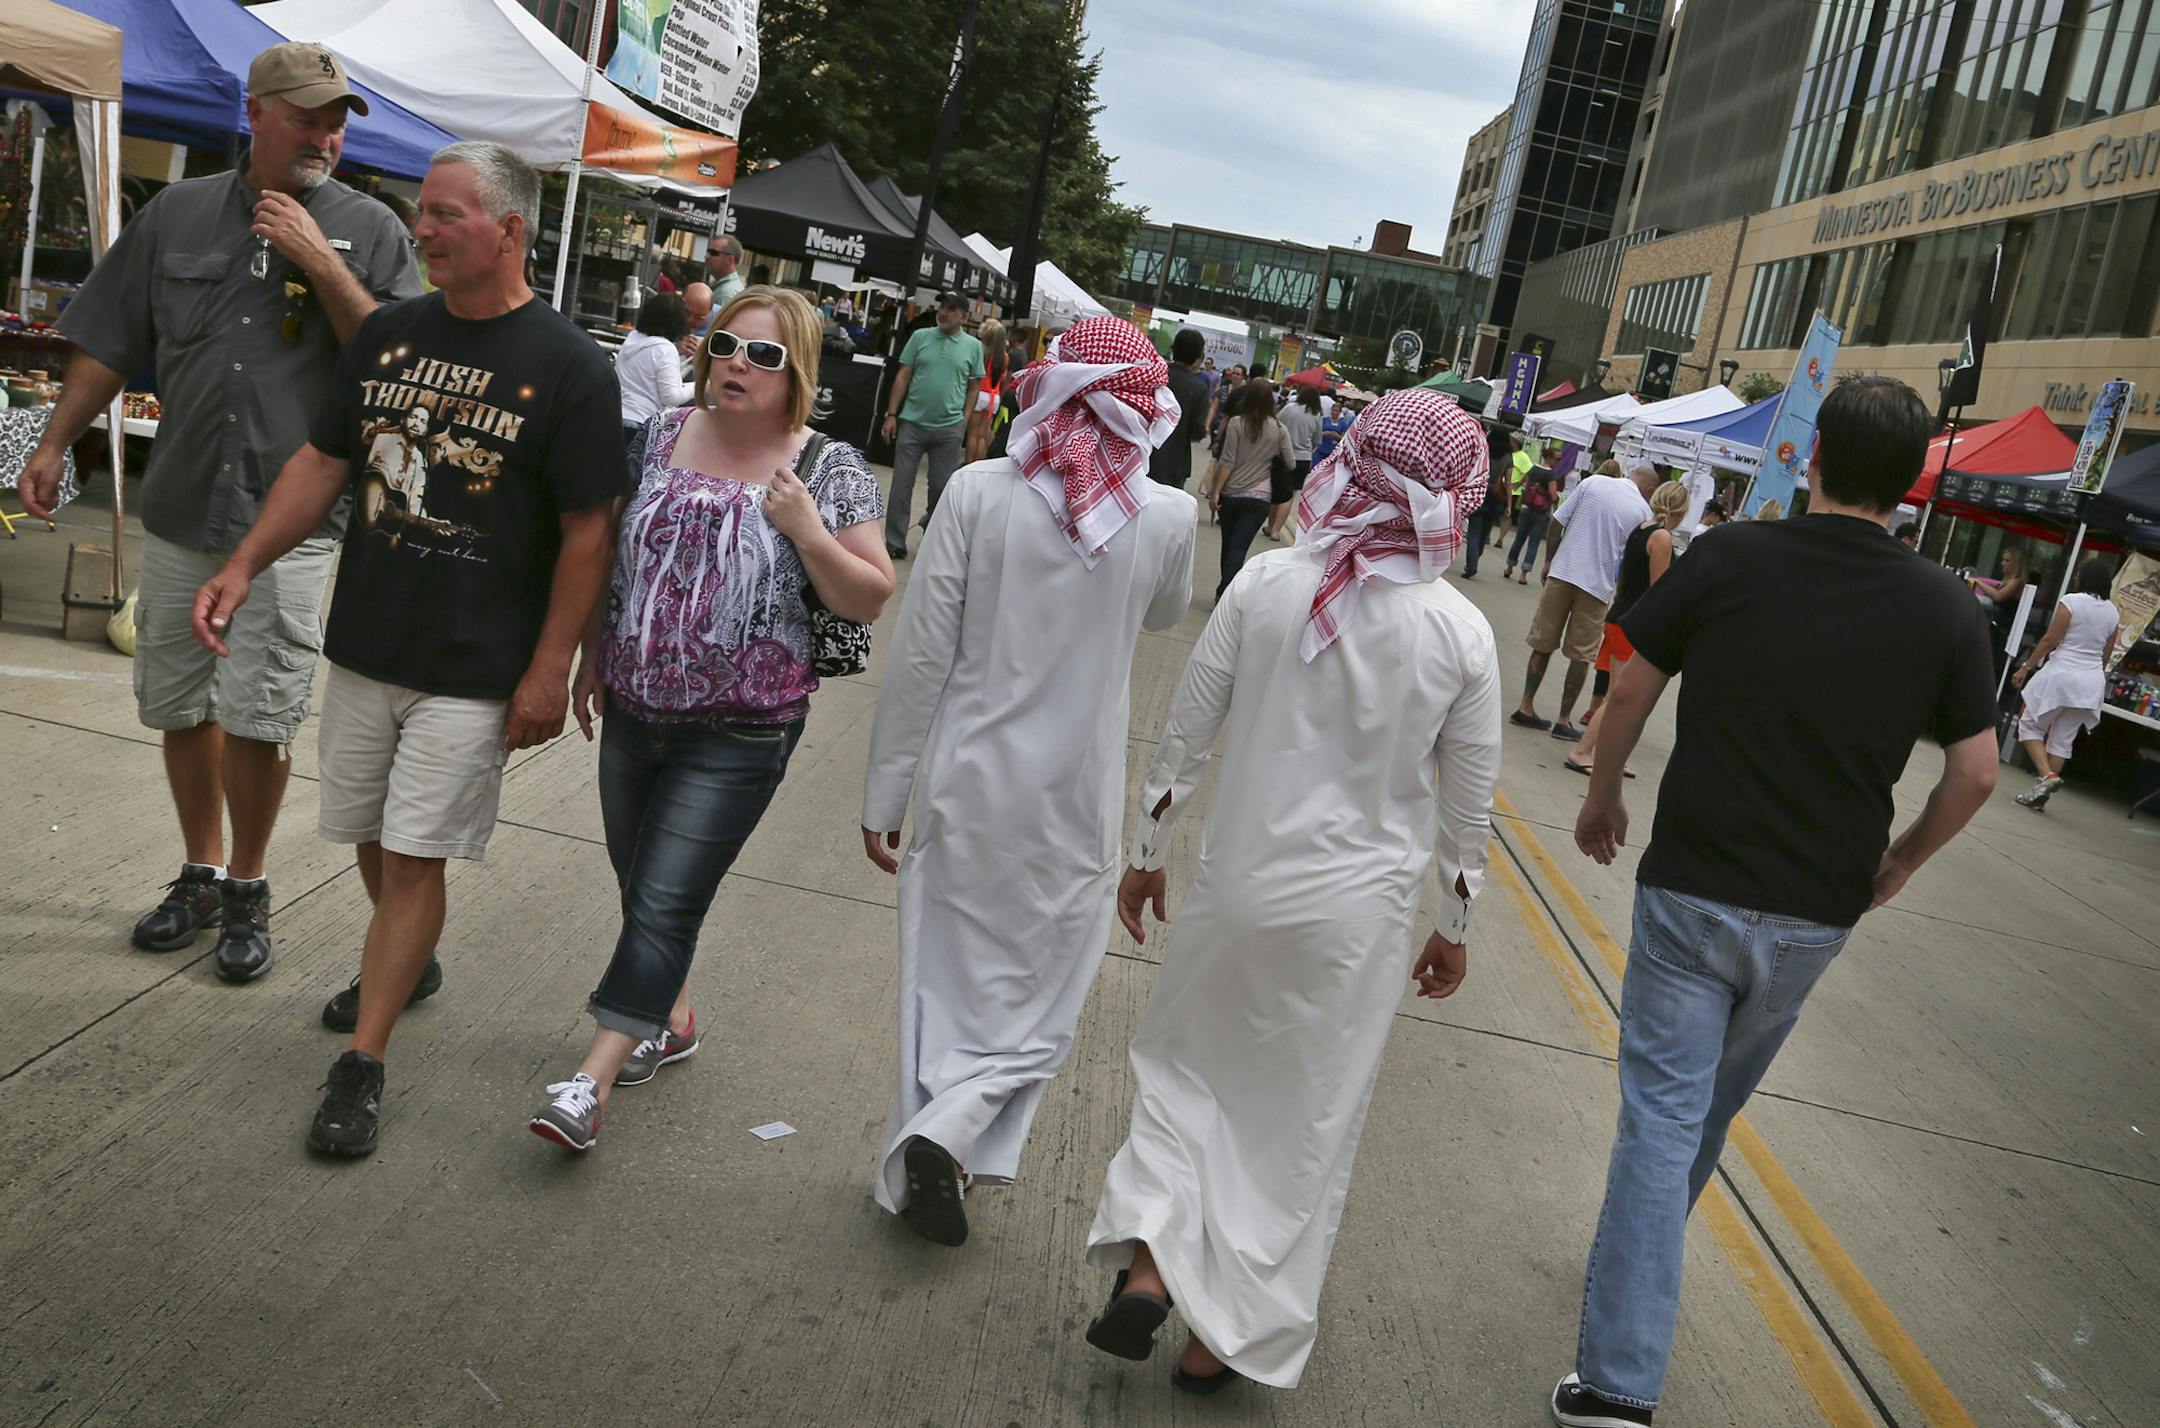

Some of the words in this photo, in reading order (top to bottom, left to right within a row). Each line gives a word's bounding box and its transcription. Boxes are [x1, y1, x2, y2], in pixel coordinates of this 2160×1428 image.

[671, 5, 686, 21] Pop
[663, 33, 695, 58] Cucumber
[666, 19, 691, 40] Bottled
[689, 31, 710, 50] Water
[1812, 191, 1912, 244] MINNESOTA
[805, 226, 866, 259] Newt's
[1205, 337, 1246, 356] STWOOD
[400, 356, 495, 398] JOSH
[360, 379, 525, 443] THOMPSON
[2044, 382, 2087, 412] Think
